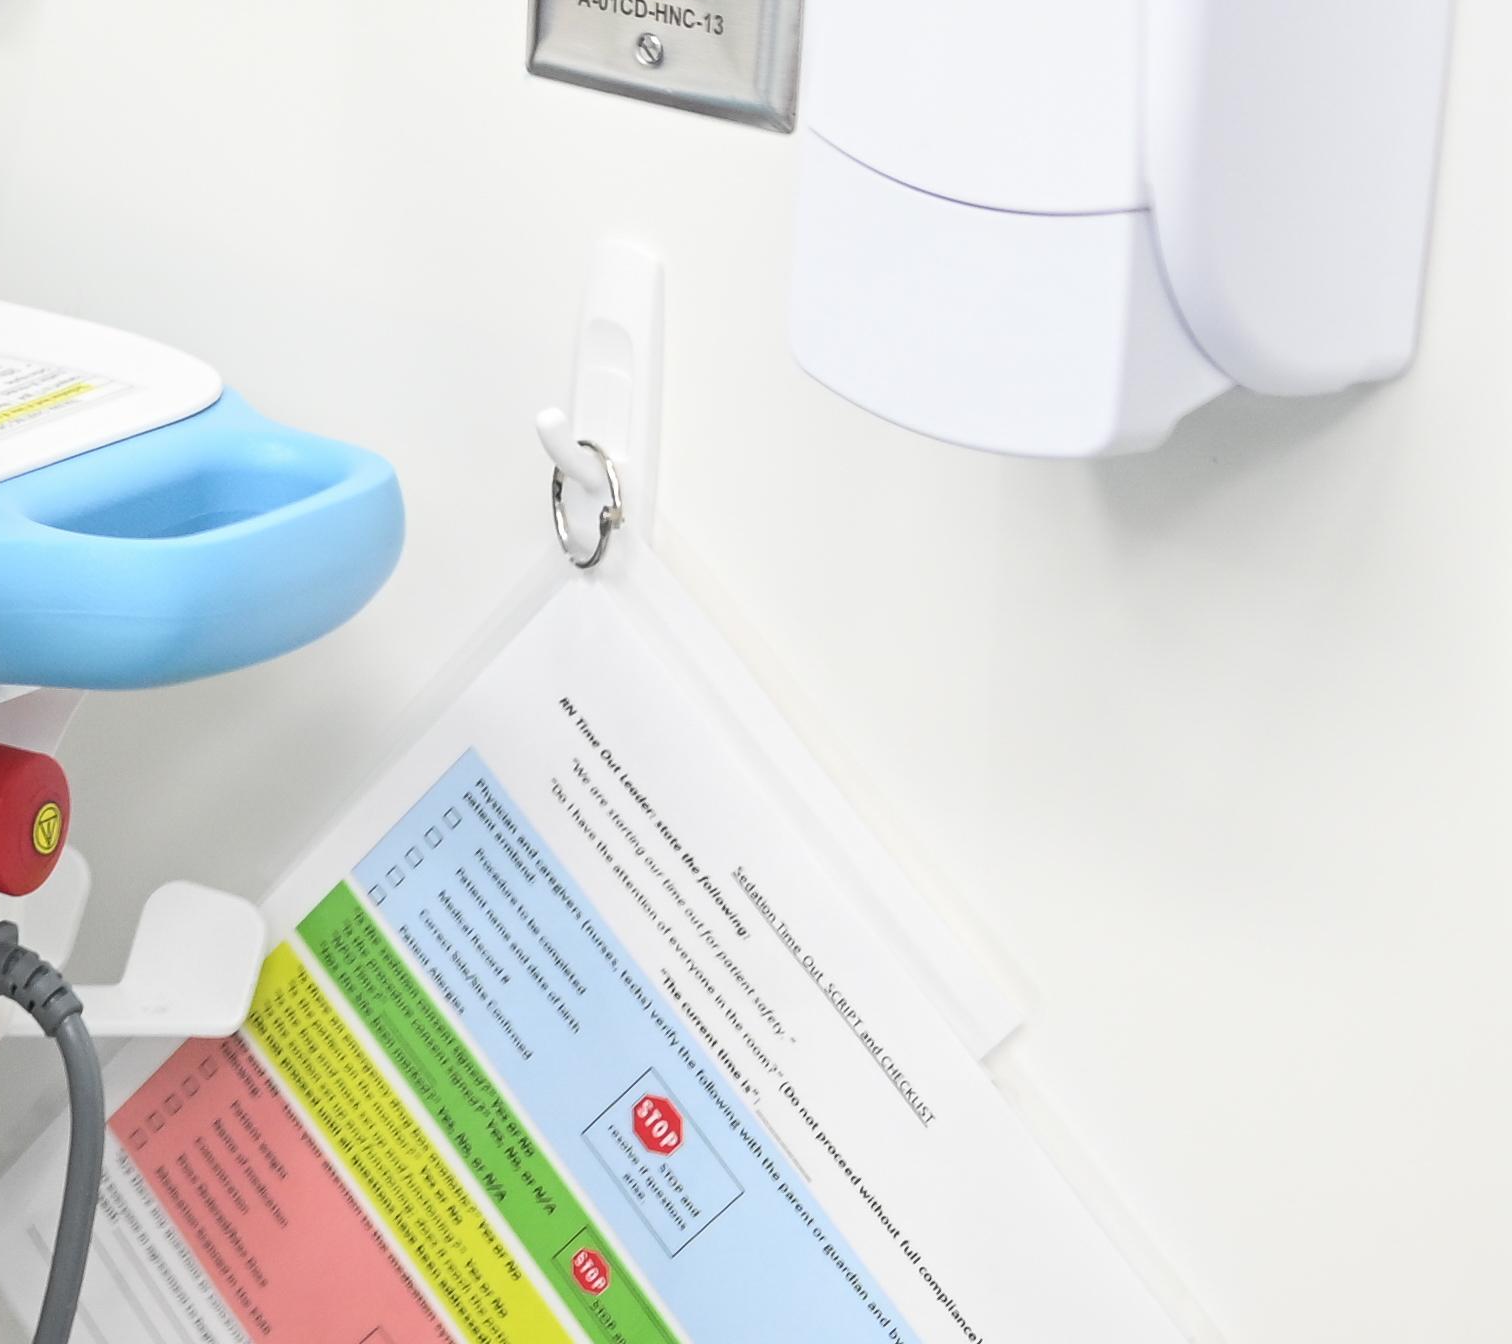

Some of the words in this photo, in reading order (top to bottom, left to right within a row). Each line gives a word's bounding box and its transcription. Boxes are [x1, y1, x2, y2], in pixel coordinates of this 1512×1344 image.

[558, 696, 578, 717] RN
[575, 717, 601, 748] Time
[599, 748, 622, 774] Out
[655, 820, 683, 852] state
[680, 852, 701, 875] the
[696, 875, 748, 937] following:
[589, 786, 609, 807] are
[607, 808, 646, 857] starting
[643, 856, 664, 877] our
[661, 878, 687, 907] time
[683, 907, 705, 931] out
[698, 929, 720, 950] for
[714, 950, 756, 996] patient
[680, 1001, 719, 1049] current
[716, 1048, 742, 1080] time
[732, 865, 777, 929] Sedation
[772, 921, 802, 958] Time
[796, 954, 825, 985] Out
[822, 982, 863, 1032] SCRIPT
[855, 1031, 884, 1060] and
[877, 1055, 936, 1128] CHECKLIST
[636, 1098, 679, 1148] STOP
[778, 1081, 800, 1107] (Do
[798, 1106, 820, 1132] not
[814, 1131, 863, 1186] proceed
[858, 1185, 901, 1240] without
[899, 1239, 922, 1266] full
[574, 1251, 607, 1290] STOP
